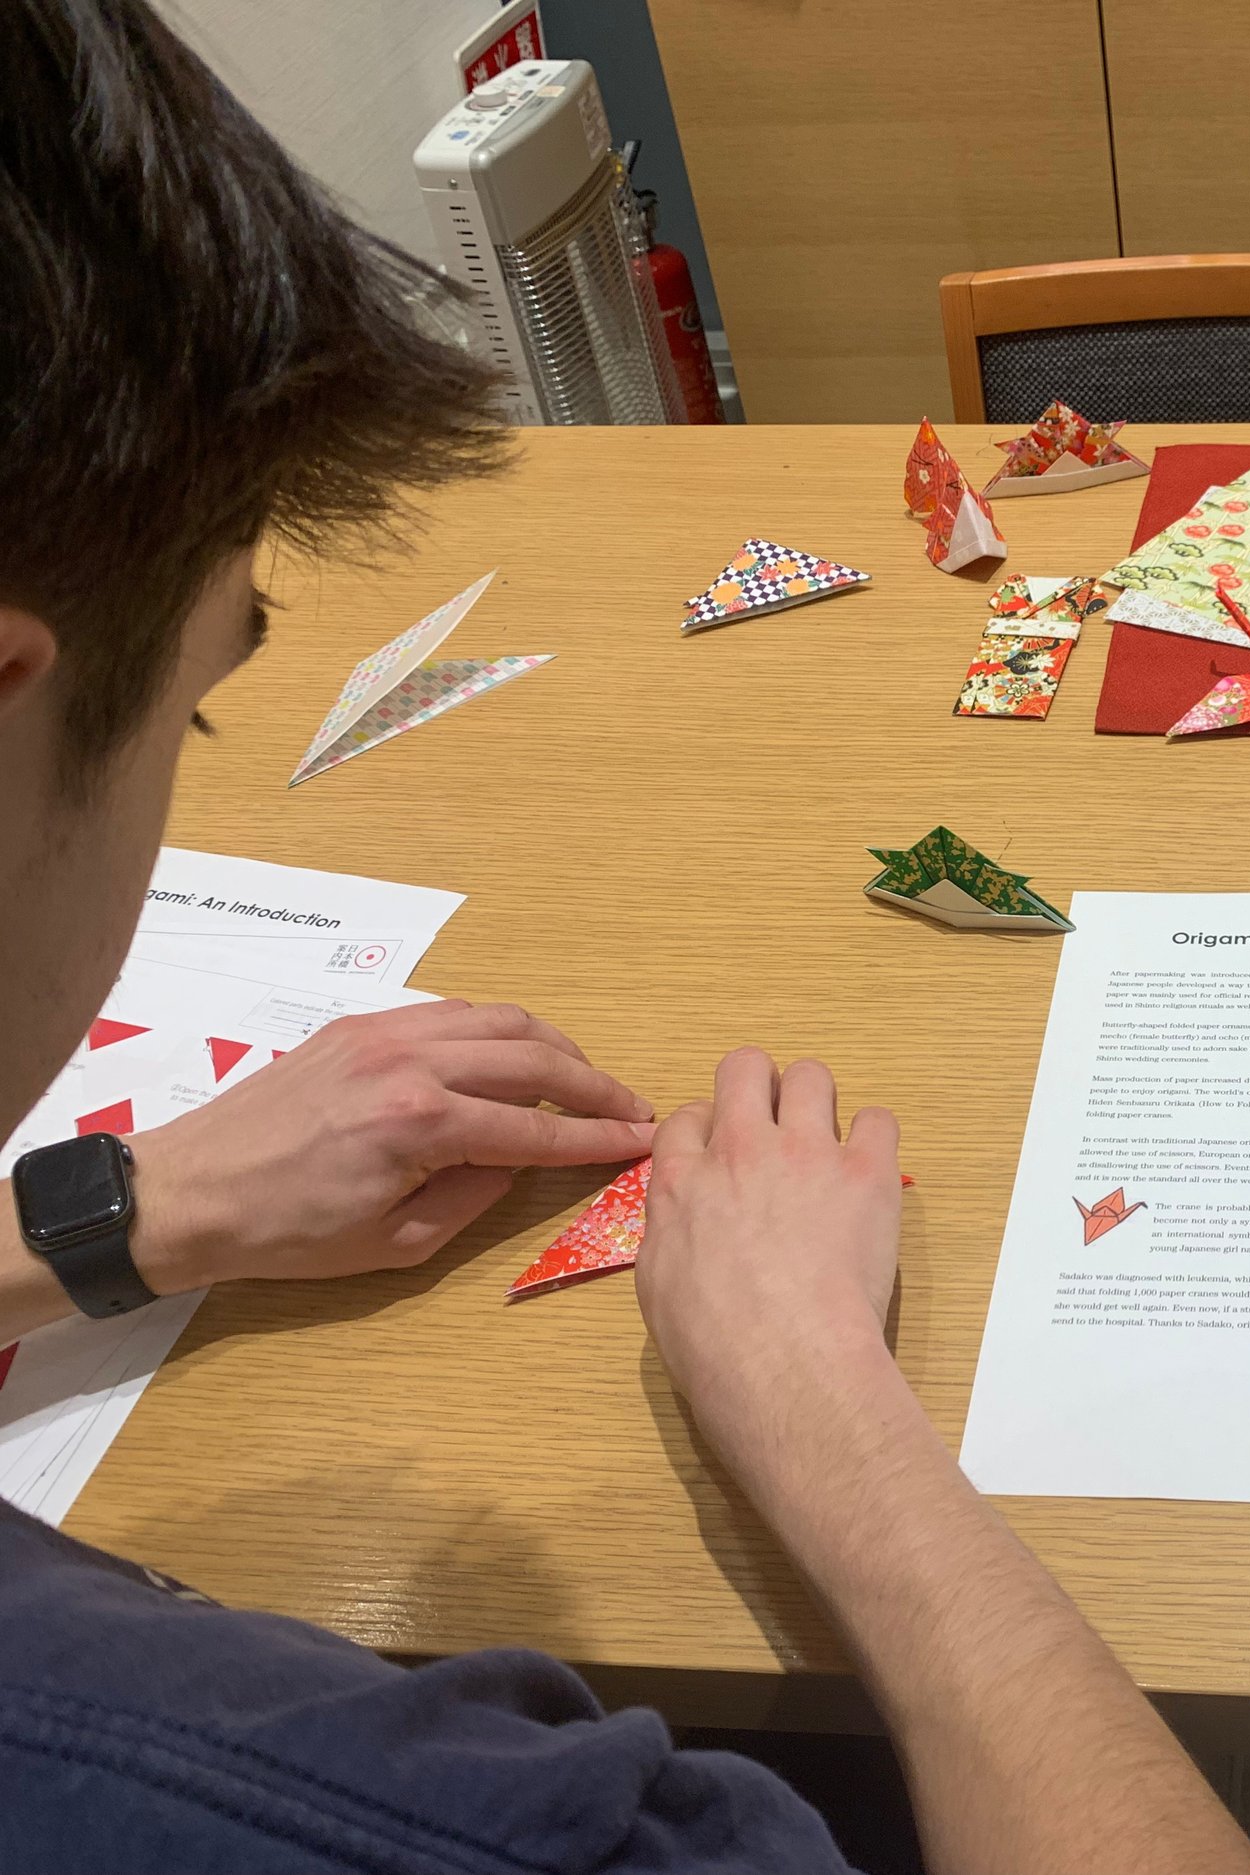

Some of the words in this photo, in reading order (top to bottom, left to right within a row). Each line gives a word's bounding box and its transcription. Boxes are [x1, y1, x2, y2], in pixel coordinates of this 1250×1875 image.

[197, 897, 226, 911] An
[228, 901, 341, 928] Introduction
[1101, 1021, 1168, 1029] Butterfly-shaped
[1161, 1033, 1200, 1041] butterfly)
[1091, 1074, 1113, 1082] Mass
[1114, 1075, 1161, 1083] production
[1085, 1110, 1116, 1119] folding
[1129, 1136, 1150, 1144] with
[1197, 1137, 1238, 1146] Japanese
[1154, 1202, 1172, 1210] The
[1152, 1216, 1189, 1224] become
[1208, 1217, 1229, 1226] only
[1148, 1245, 1178, 1253] young
[1178, 1244, 1221, 1253] Japanese
[1222, 1245, 1239, 1254] girl
[1058, 1272, 1093, 1280] Sadako
[1114, 1273, 1162, 1282] diagnosed
[1164, 1274, 1185, 1282] with
[1186, 1274, 1232, 1283] leukemia,
[1053, 1301, 1071, 1309] she
[1072, 1302, 1102, 1310] would
[1102, 1303, 1118, 1312] get
[1120, 1302, 1141, 1311] well
[1141, 1303, 1170, 1312] again.
[1171, 1303, 1196, 1312] Even
[1197, 1305, 1221, 1314] now,
